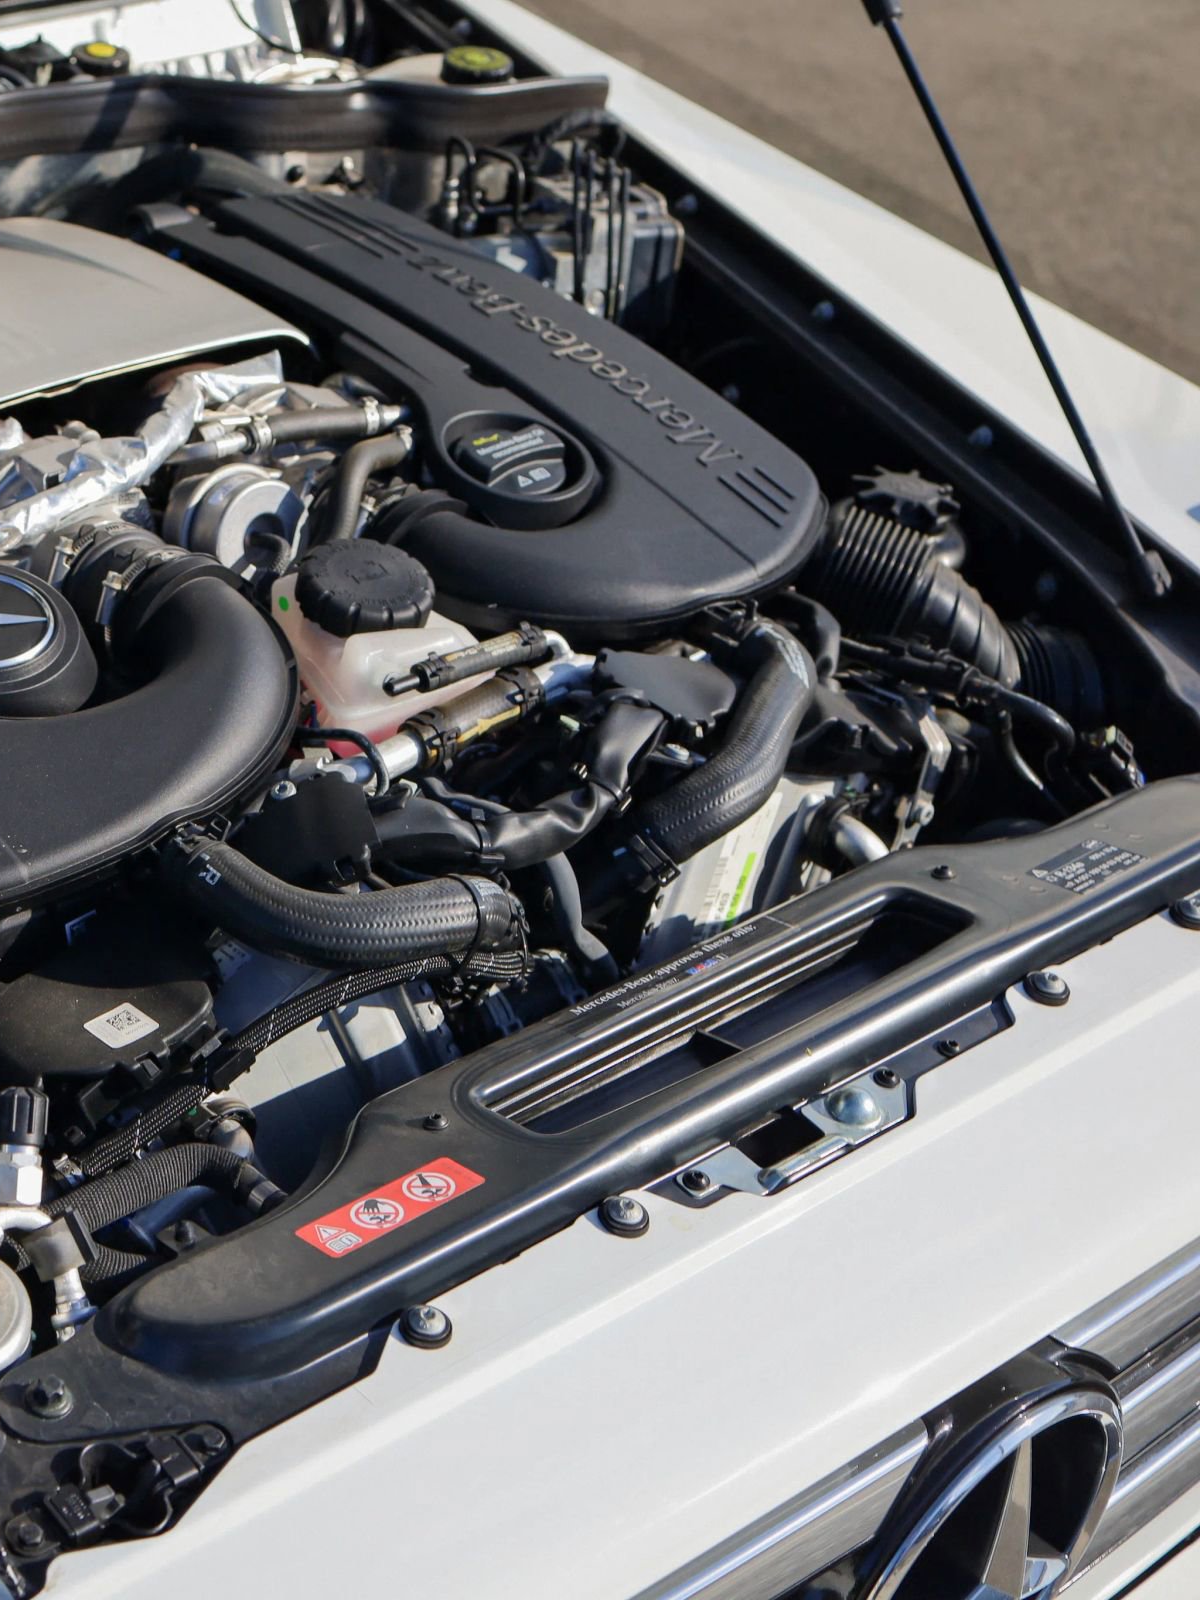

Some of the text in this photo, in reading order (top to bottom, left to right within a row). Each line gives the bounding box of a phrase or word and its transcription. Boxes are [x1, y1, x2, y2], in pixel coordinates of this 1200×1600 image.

[407, 255, 743, 468] Mercedes-Benz
[569, 971, 656, 1016] Mercedes-Benz
[654, 950, 704, 979] approves
[702, 935, 734, 954] these
[616, 976, 680, 1009] Mercedes-Benz
